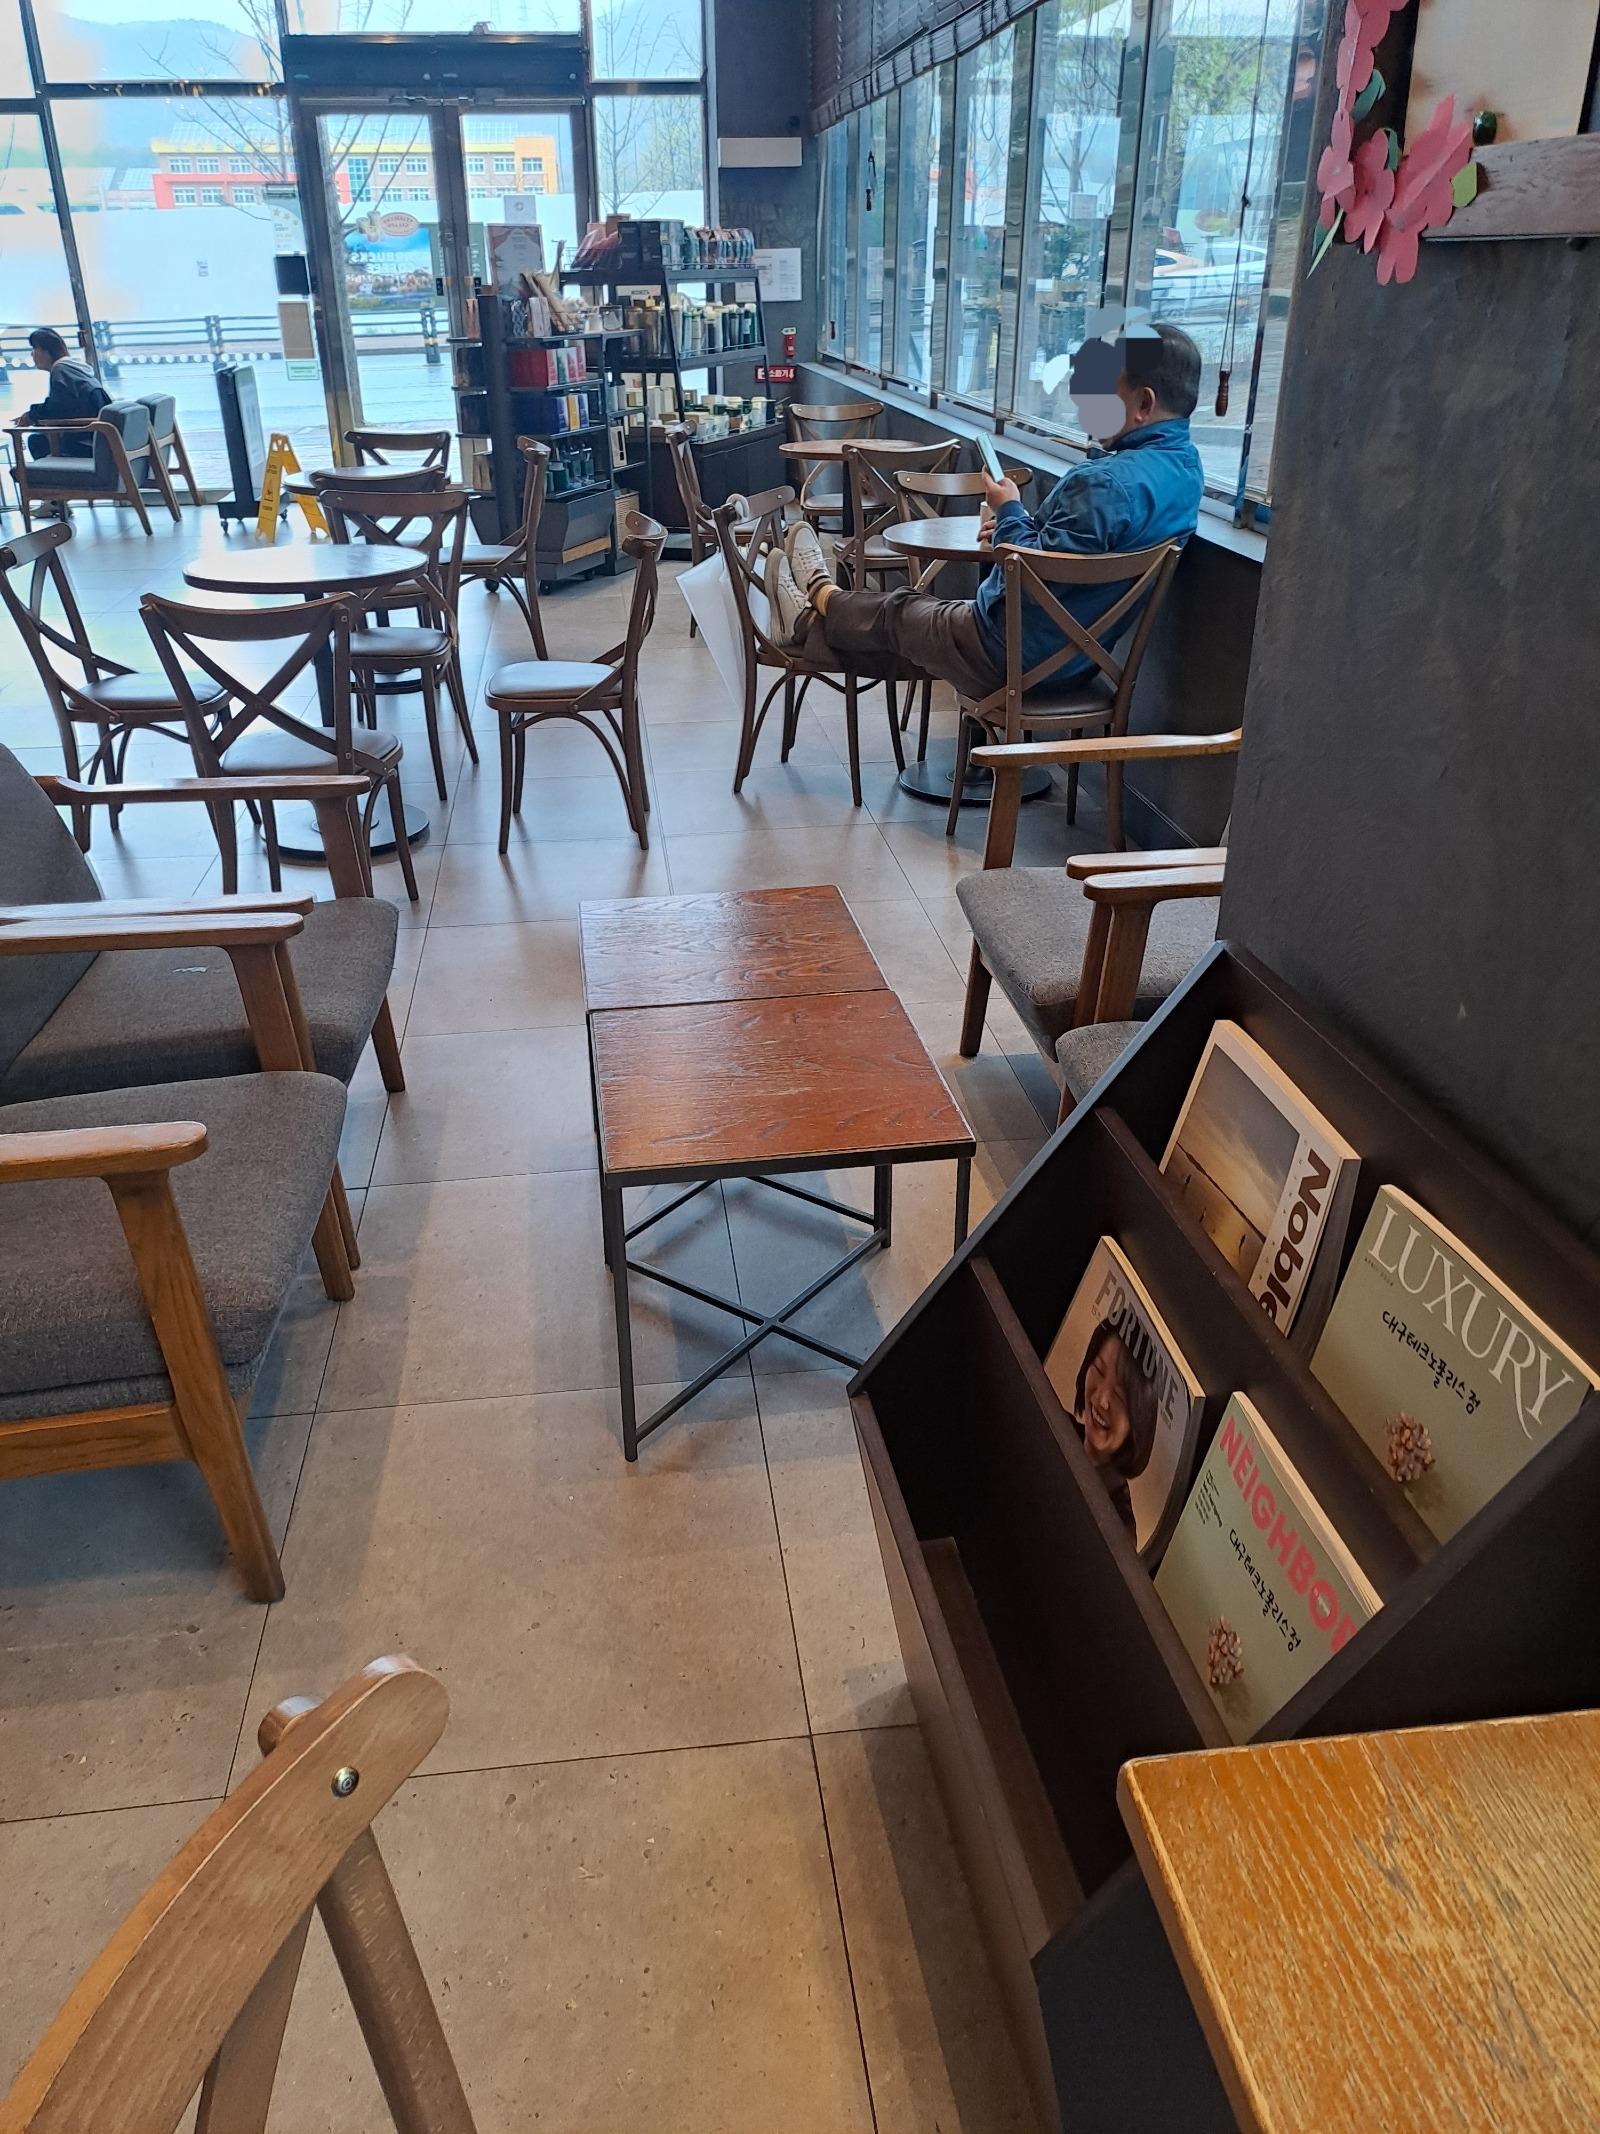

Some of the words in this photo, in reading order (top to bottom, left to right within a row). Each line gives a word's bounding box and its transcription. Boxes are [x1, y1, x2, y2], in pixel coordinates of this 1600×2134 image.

[1094, 1270, 1179, 1430] FORTUNE
[1368, 1204, 1575, 1440] LUXURY
[1381, 1310, 1481, 1415] 대구테크노폴리스점
[1229, 1528, 1302, 1652] 대구테크노폴리스점
